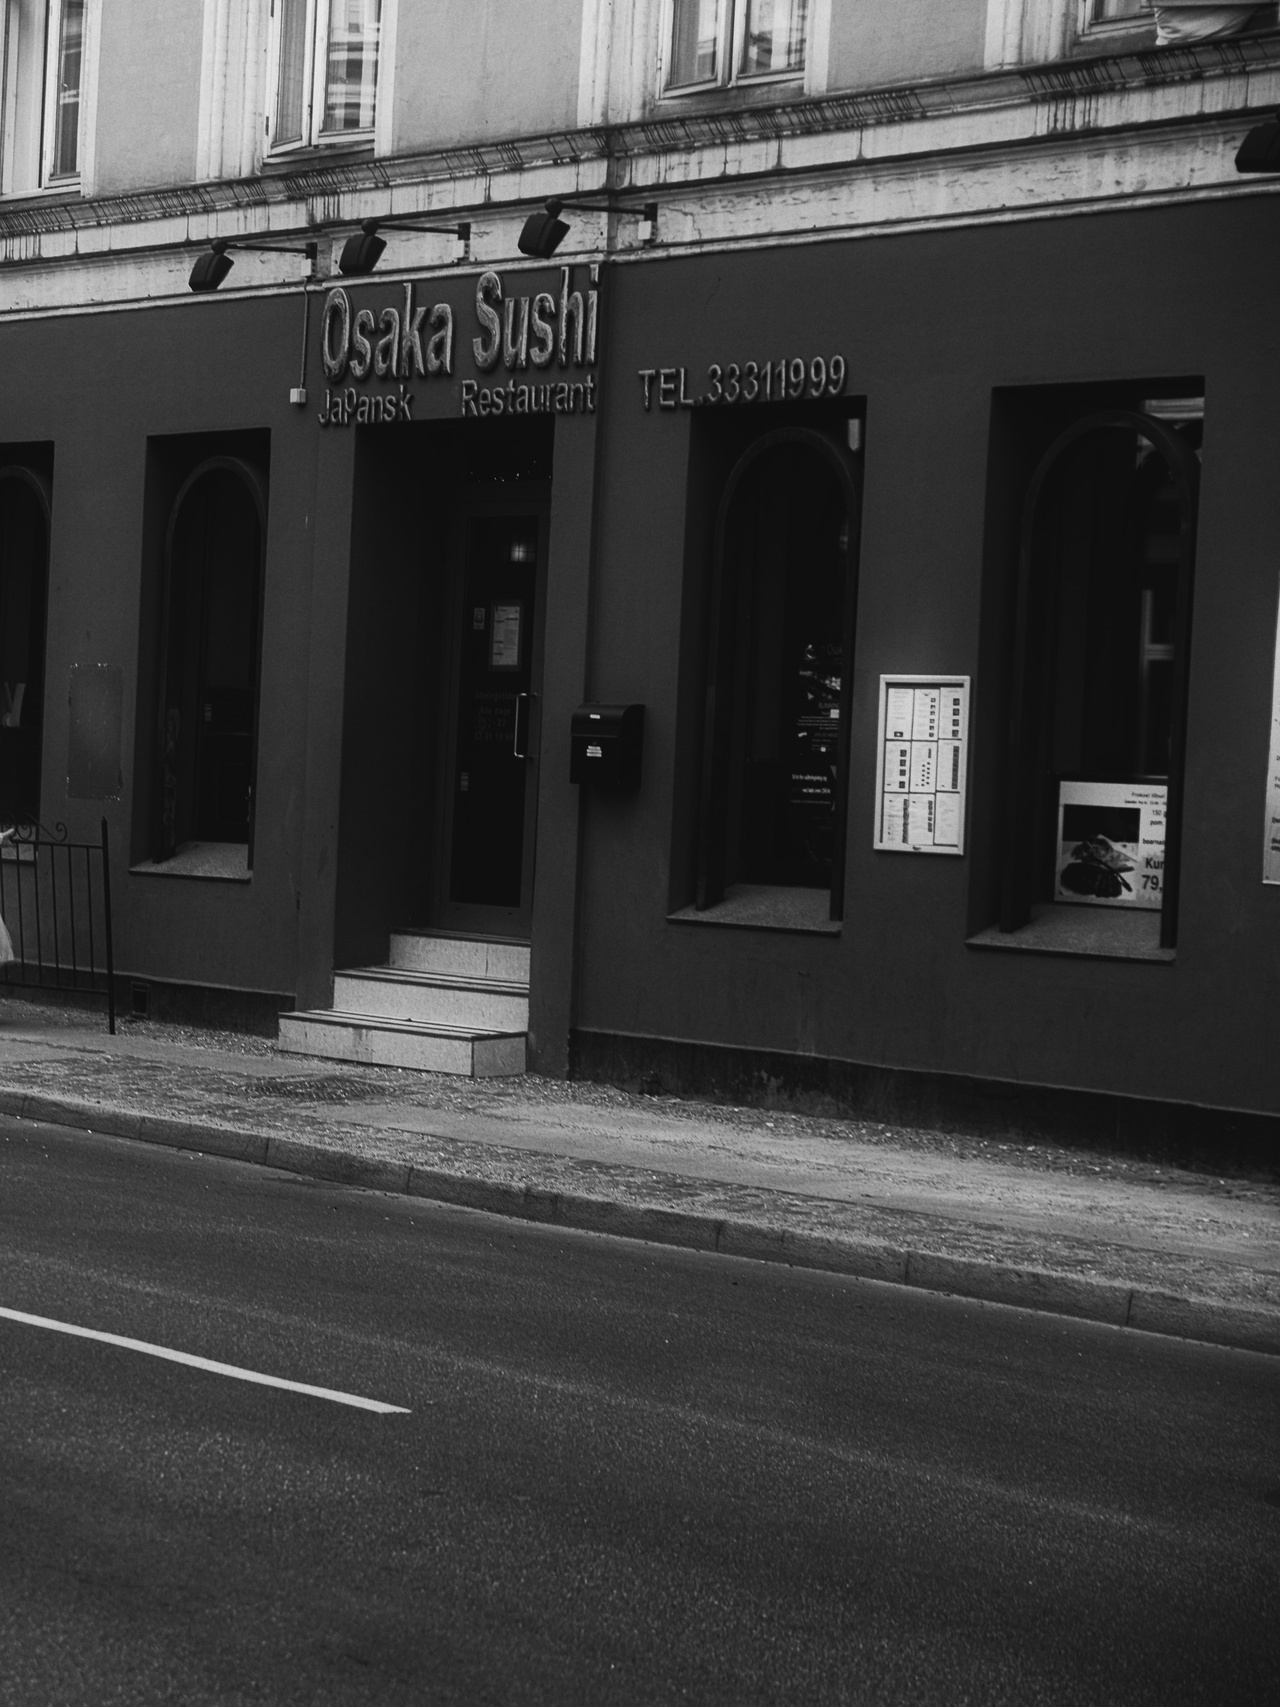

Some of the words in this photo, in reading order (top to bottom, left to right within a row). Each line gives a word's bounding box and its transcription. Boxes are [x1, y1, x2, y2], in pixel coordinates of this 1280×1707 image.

[321, 282, 454, 383] Osaka
[472, 263, 599, 372] Sushi
[461, 374, 595, 418] Restaurant
